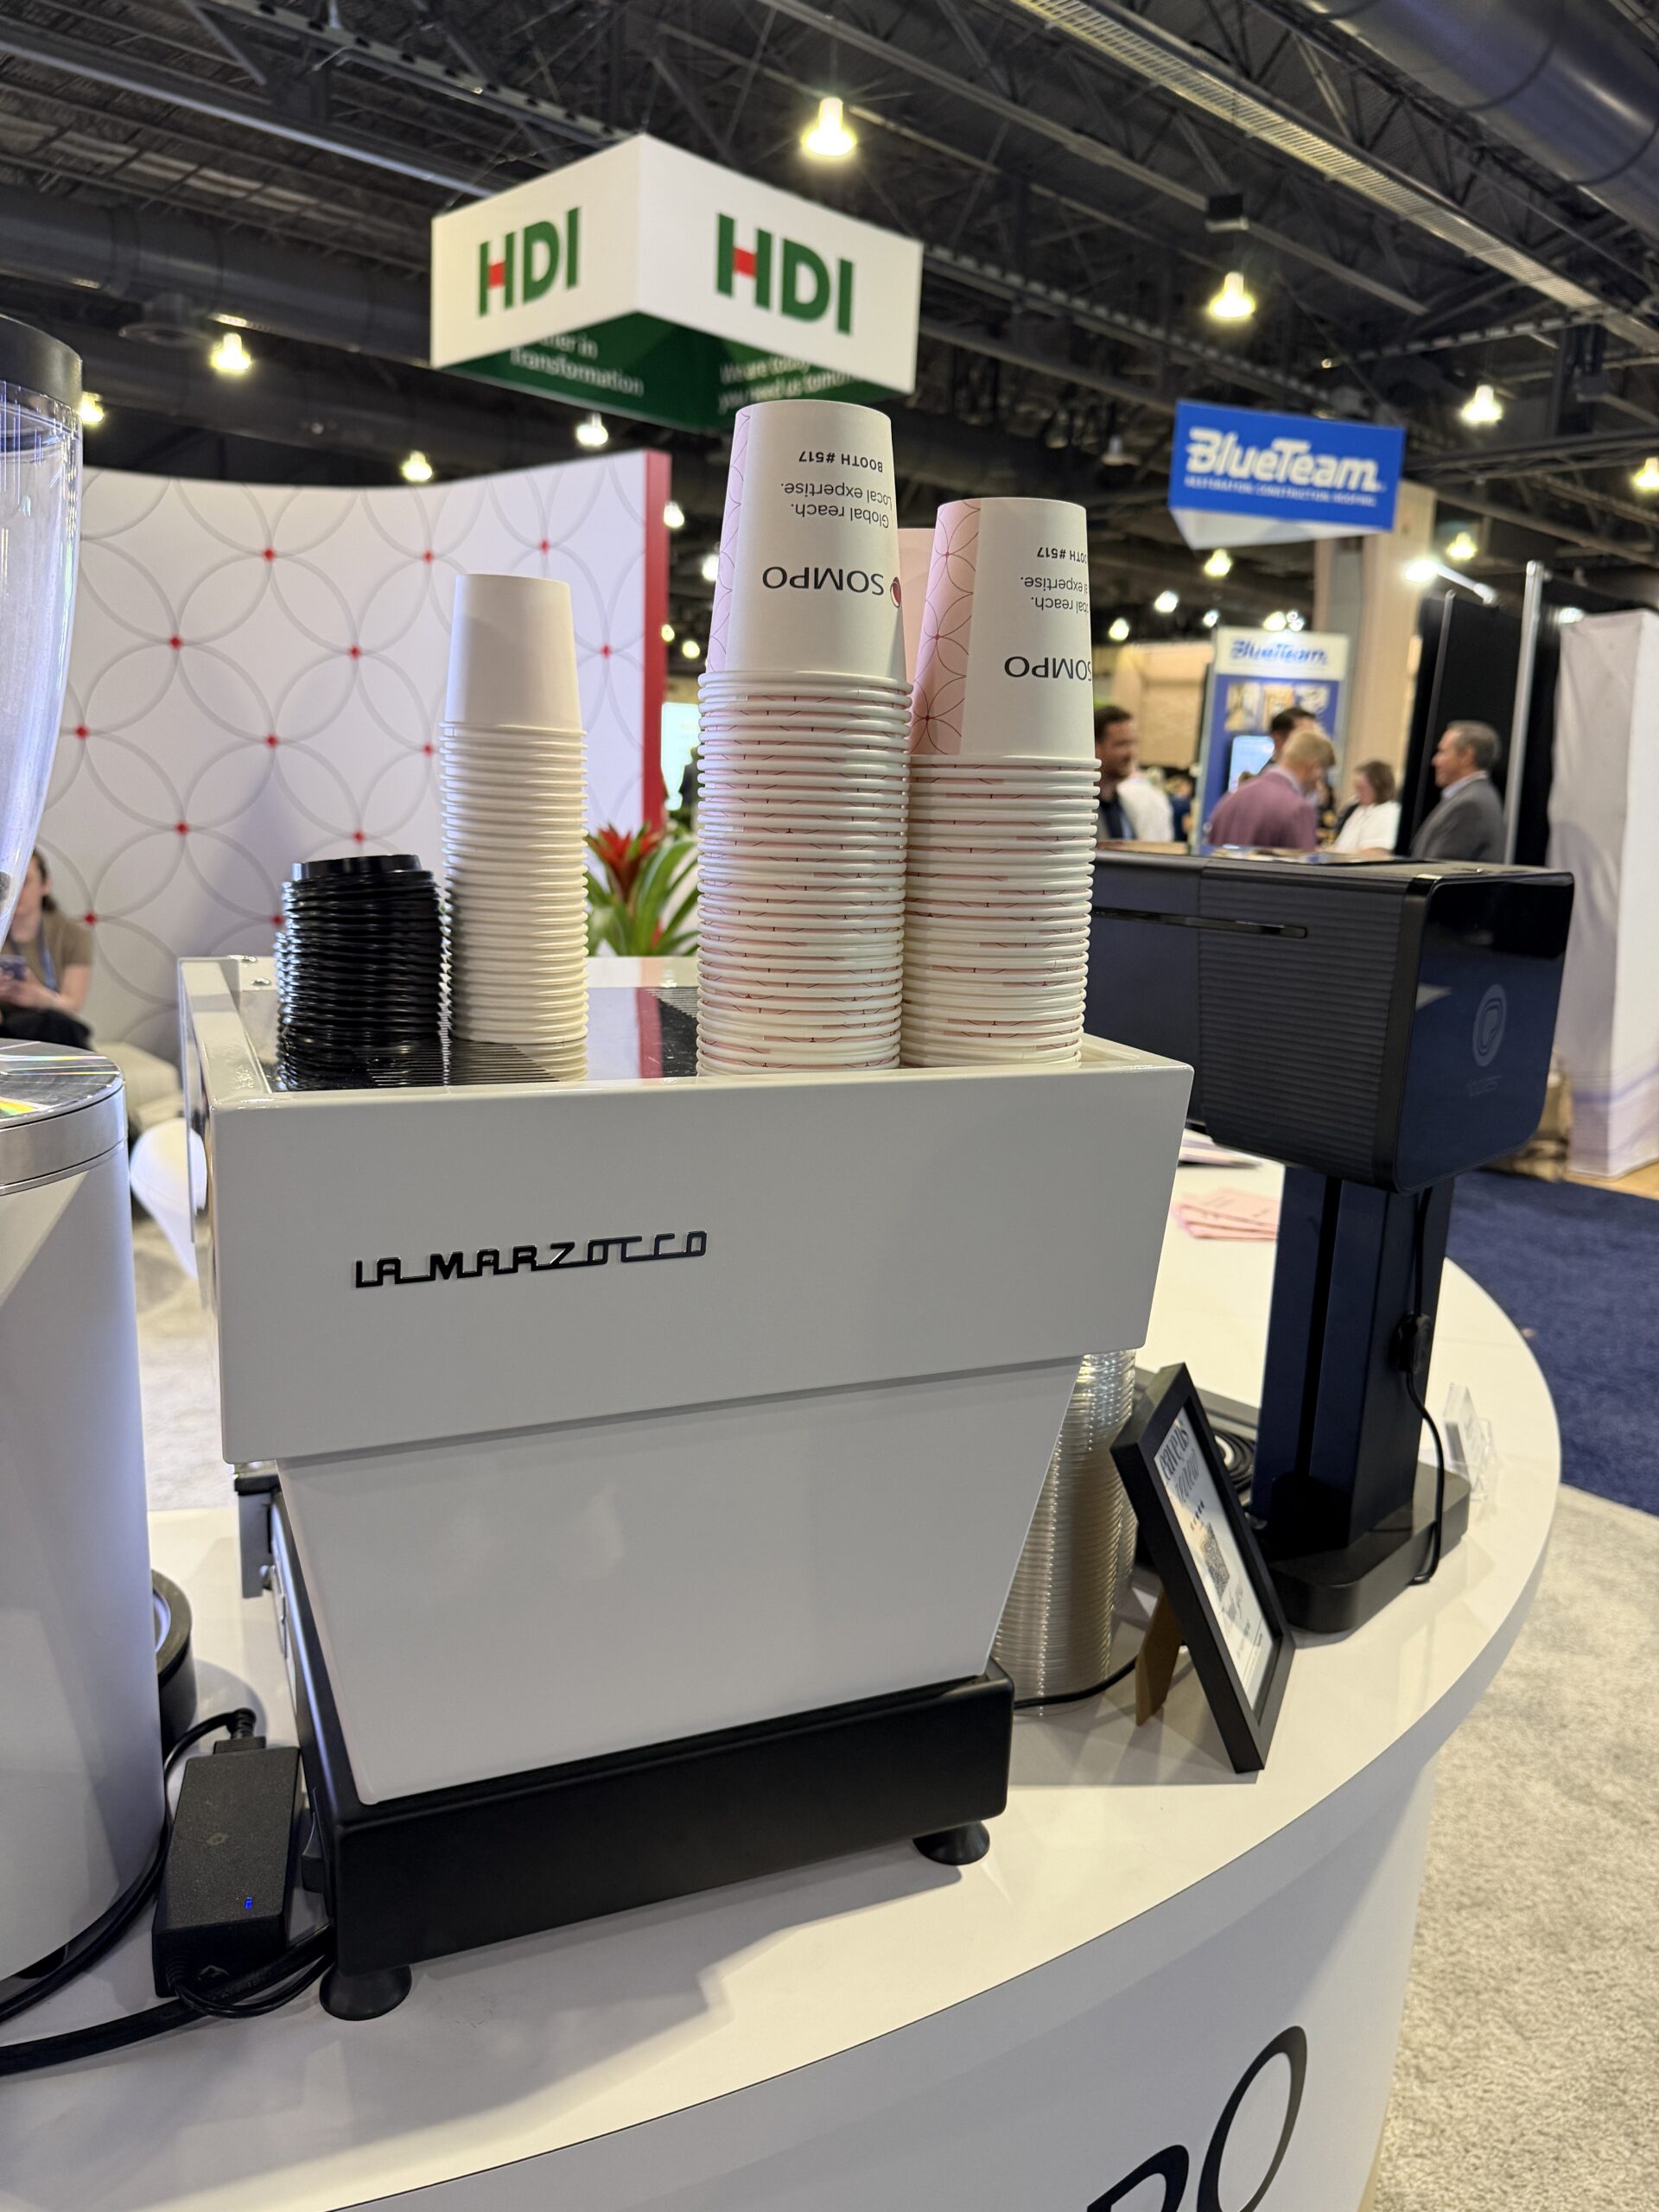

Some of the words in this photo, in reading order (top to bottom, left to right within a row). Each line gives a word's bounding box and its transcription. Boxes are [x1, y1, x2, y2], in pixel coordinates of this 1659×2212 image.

[478, 206, 582, 318] HDI
[716, 213, 854, 336] HDI
[510, 346, 646, 398] Transformation
[744, 360, 767, 381] are
[798, 450, 836, 464] #517
[841, 453, 884, 473] BOOTH
[1185, 428, 1383, 493] BlueTeam
[780, 481, 863, 499] expertise.
[866, 490, 893, 511] Local
[791, 503, 845, 518] reach.
[850, 507, 889, 529] Global
[1037, 547, 1066, 560] #517
[762, 566, 885, 596] SOMPO
[1020, 576, 1084, 593] expertise.
[1030, 596, 1074, 612] reach.
[1230, 639, 1328, 666] BlueTeam
[355, 1255, 401, 1288] LA
[430, 1230, 708, 1281] MARZOCCO
